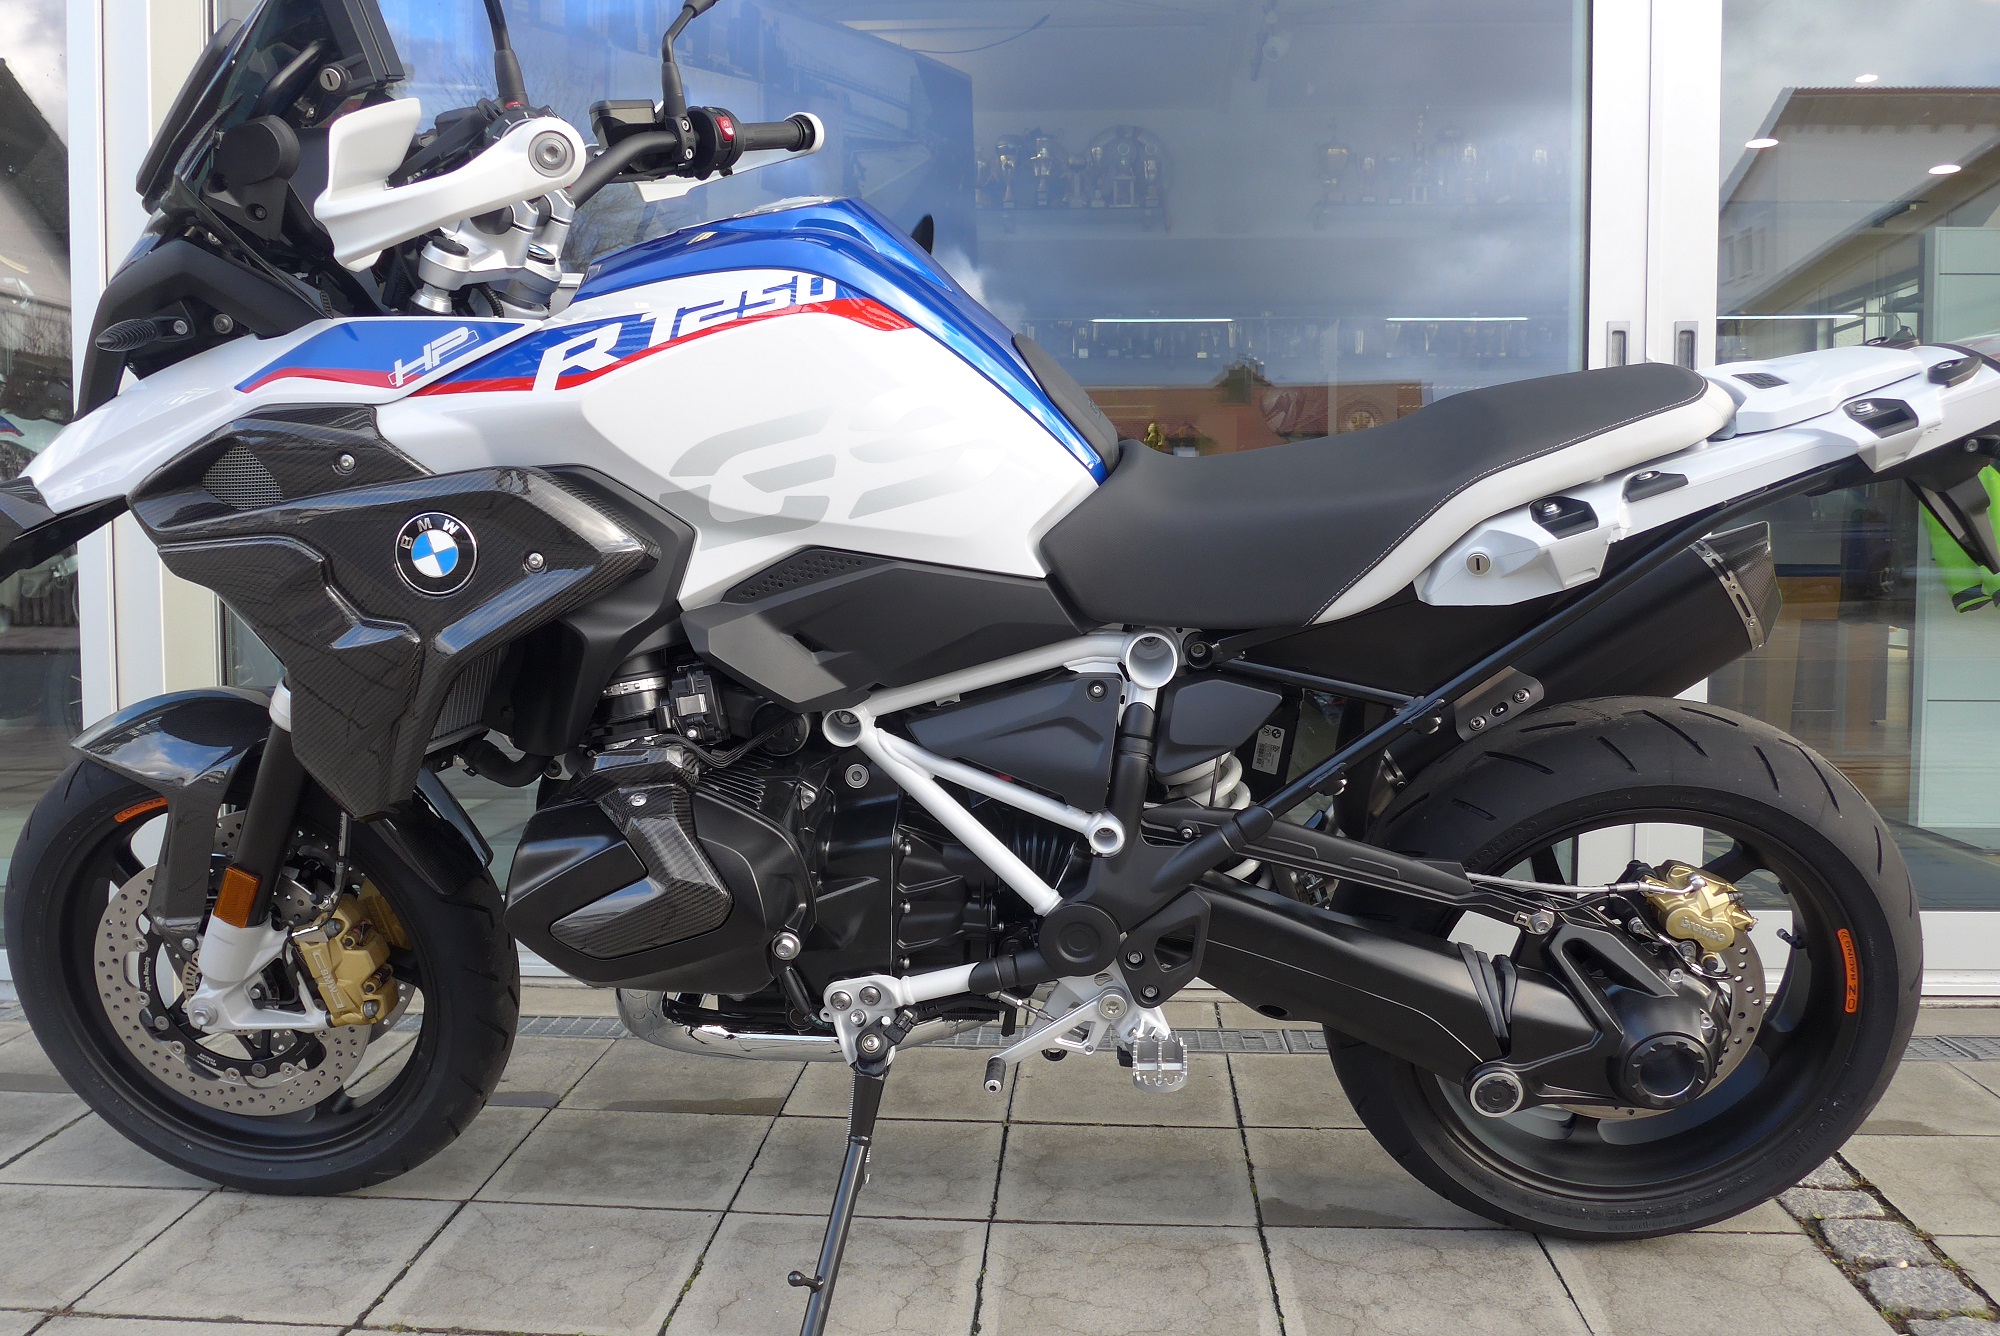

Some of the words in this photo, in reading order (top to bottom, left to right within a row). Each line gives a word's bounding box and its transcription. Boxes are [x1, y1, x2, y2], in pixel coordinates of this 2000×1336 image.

[393, 326, 469, 387] HP
[532, 321, 622, 391] R
[658, 386, 1003, 551] GS
[400, 517, 460, 550] BMW
[1680, 915, 1726, 942] brembo
[321, 968, 338, 994] BMW
[1844, 940, 1857, 981] RACING
